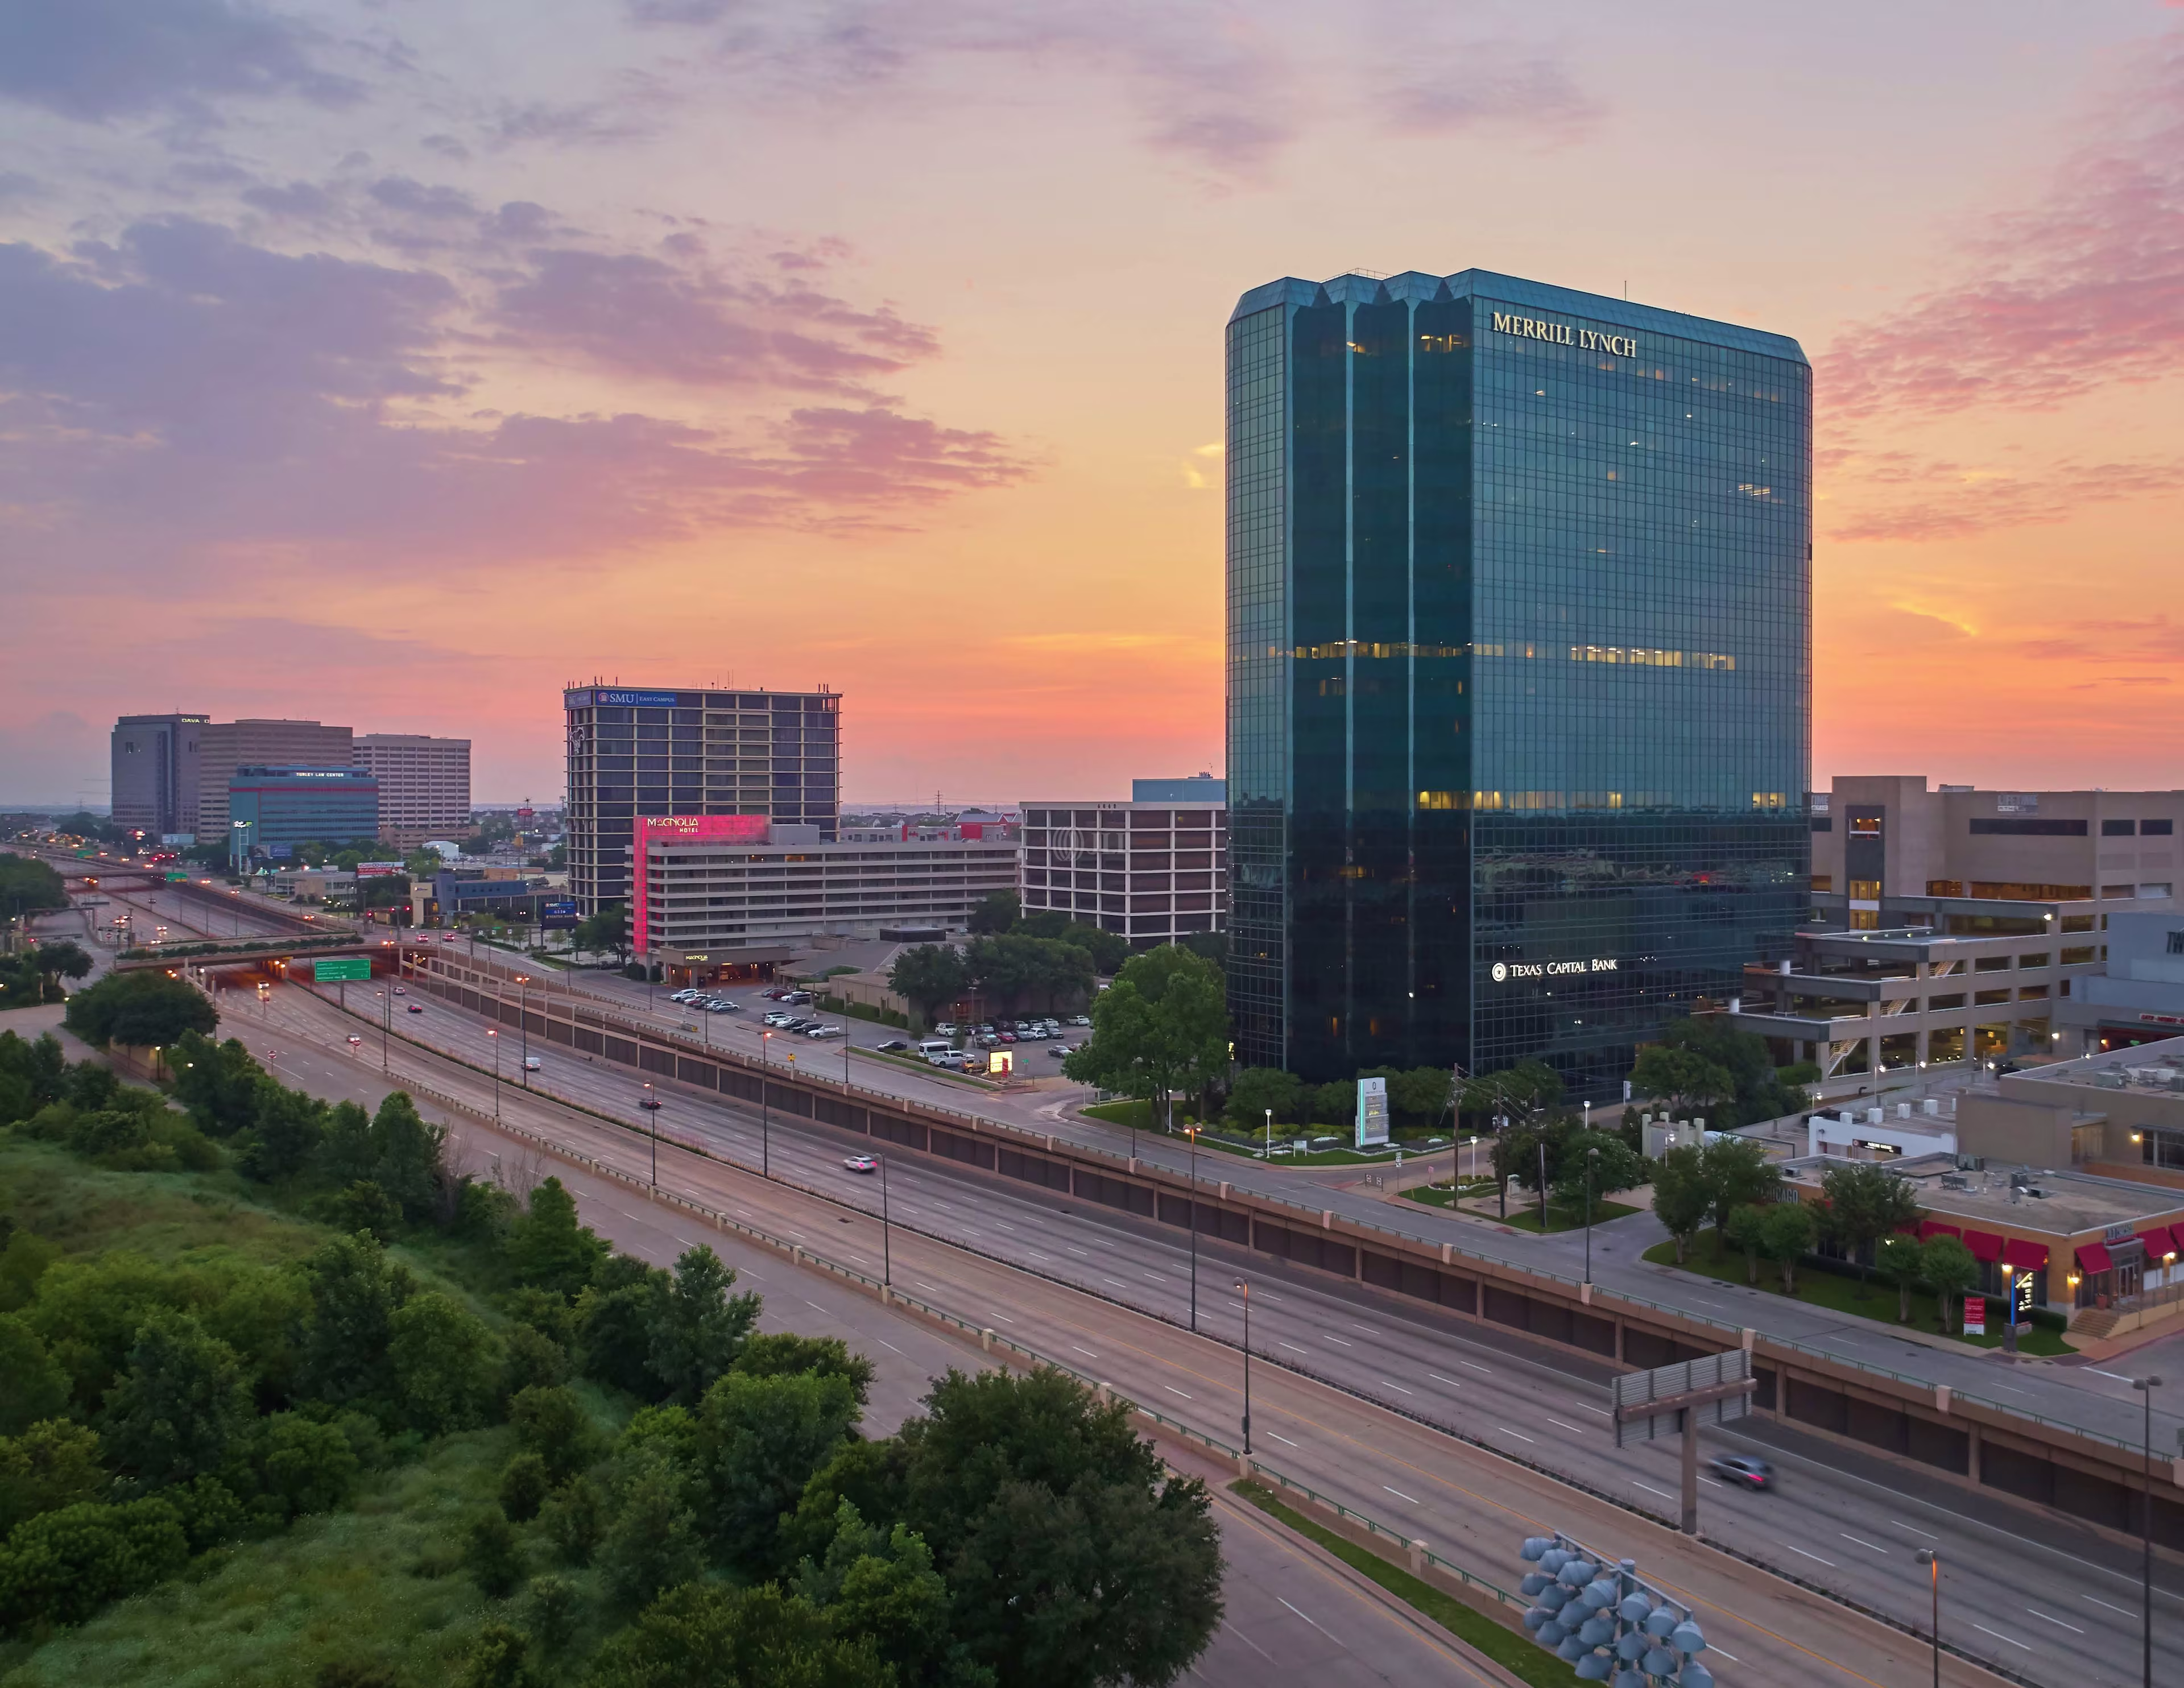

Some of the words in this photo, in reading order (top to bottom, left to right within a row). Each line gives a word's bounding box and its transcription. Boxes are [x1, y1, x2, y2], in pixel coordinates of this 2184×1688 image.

[1493, 312, 1574, 346] MERRILL
[1578, 329, 1637, 358] LYNCH
[609, 693, 634, 703] SMU
[647, 818, 698, 827] MAGNOLIA
[1509, 964, 1542, 977] TEXAS
[1546, 961, 1587, 974] CAPITAL
[1591, 959, 1618, 971] BANK
